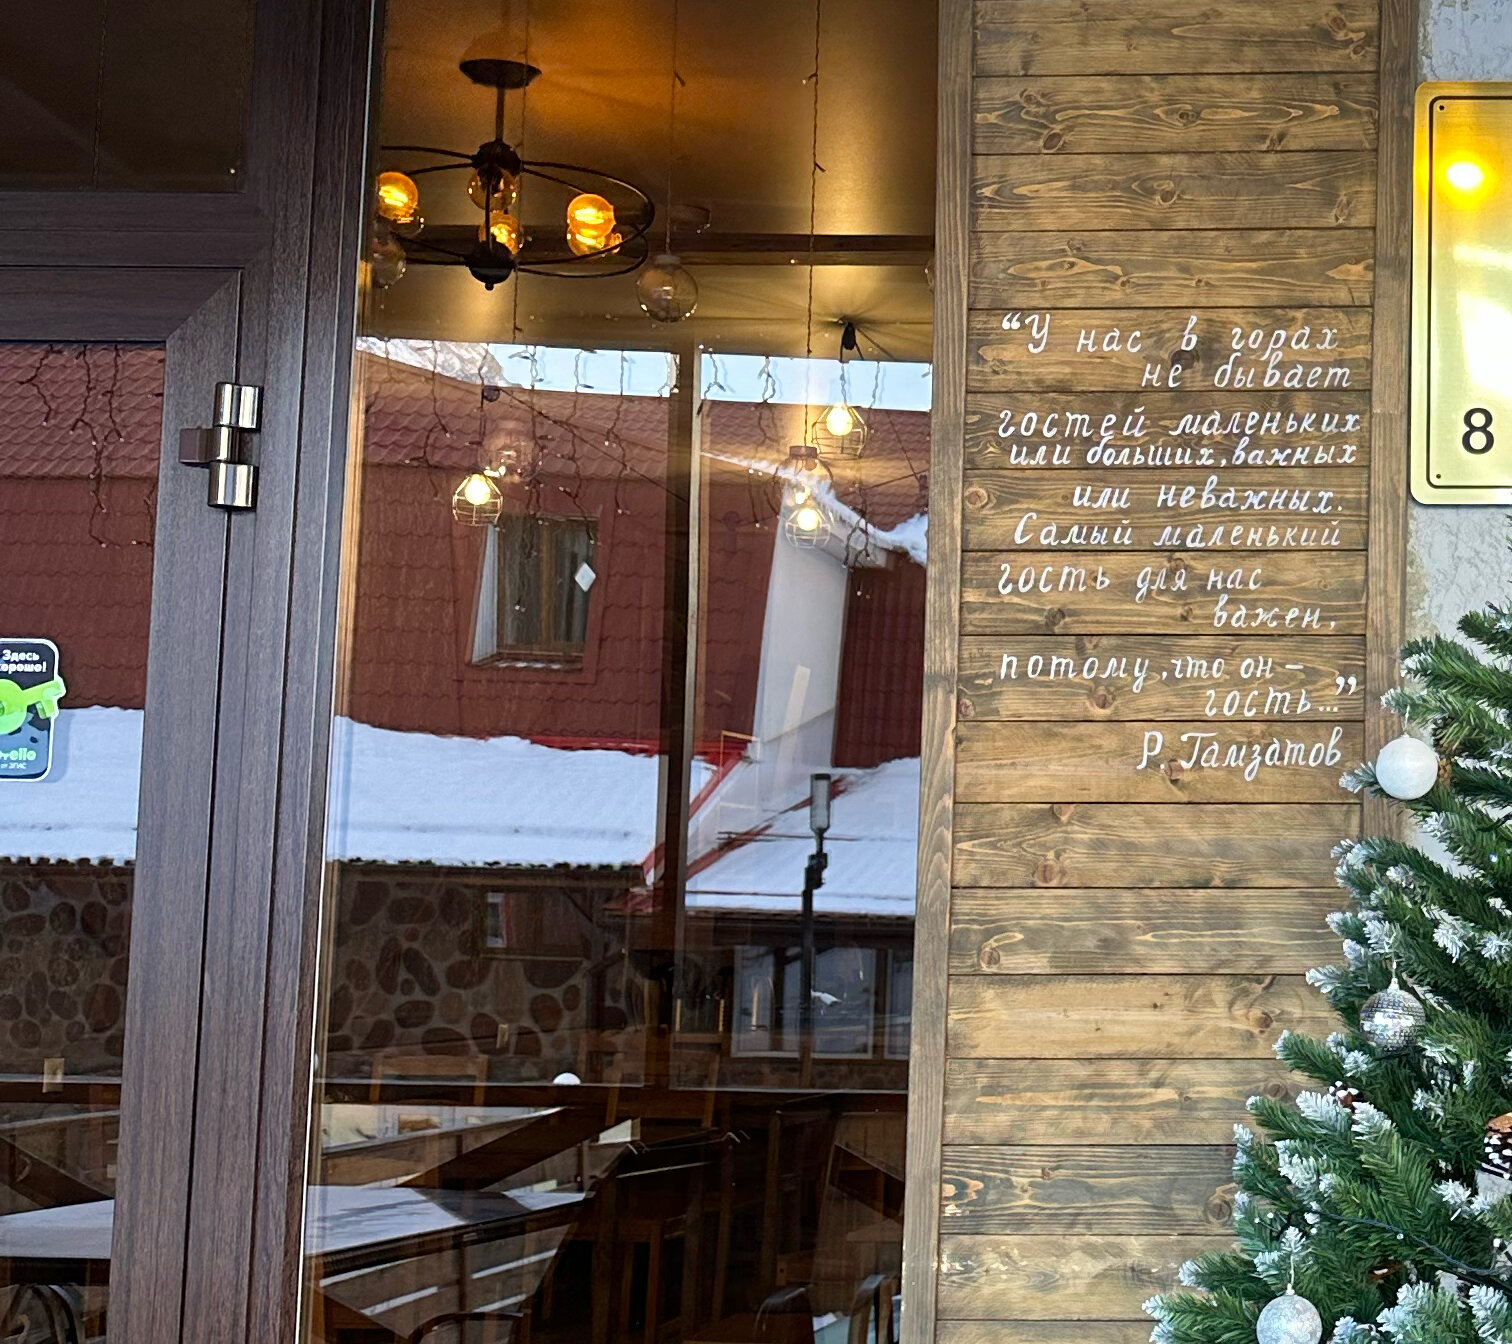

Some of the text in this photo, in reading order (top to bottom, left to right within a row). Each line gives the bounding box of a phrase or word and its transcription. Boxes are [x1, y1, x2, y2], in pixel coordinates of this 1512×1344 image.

[1077, 328, 1142, 353] нас
[1181, 315, 1198, 352] в
[1232, 326, 1338, 360] горах
[1142, 353, 1352, 388] не бывает
[998, 406, 1360, 438] гостей маленьких
[1462, 407, 1495, 455] 8
[1010, 444, 1071, 466] или
[1073, 475, 1343, 514] или неважных.
[1014, 513, 1341, 548] Самый маленький
[998, 564, 1261, 603] гость для нас
[2, 649, 39, 662] Здесь
